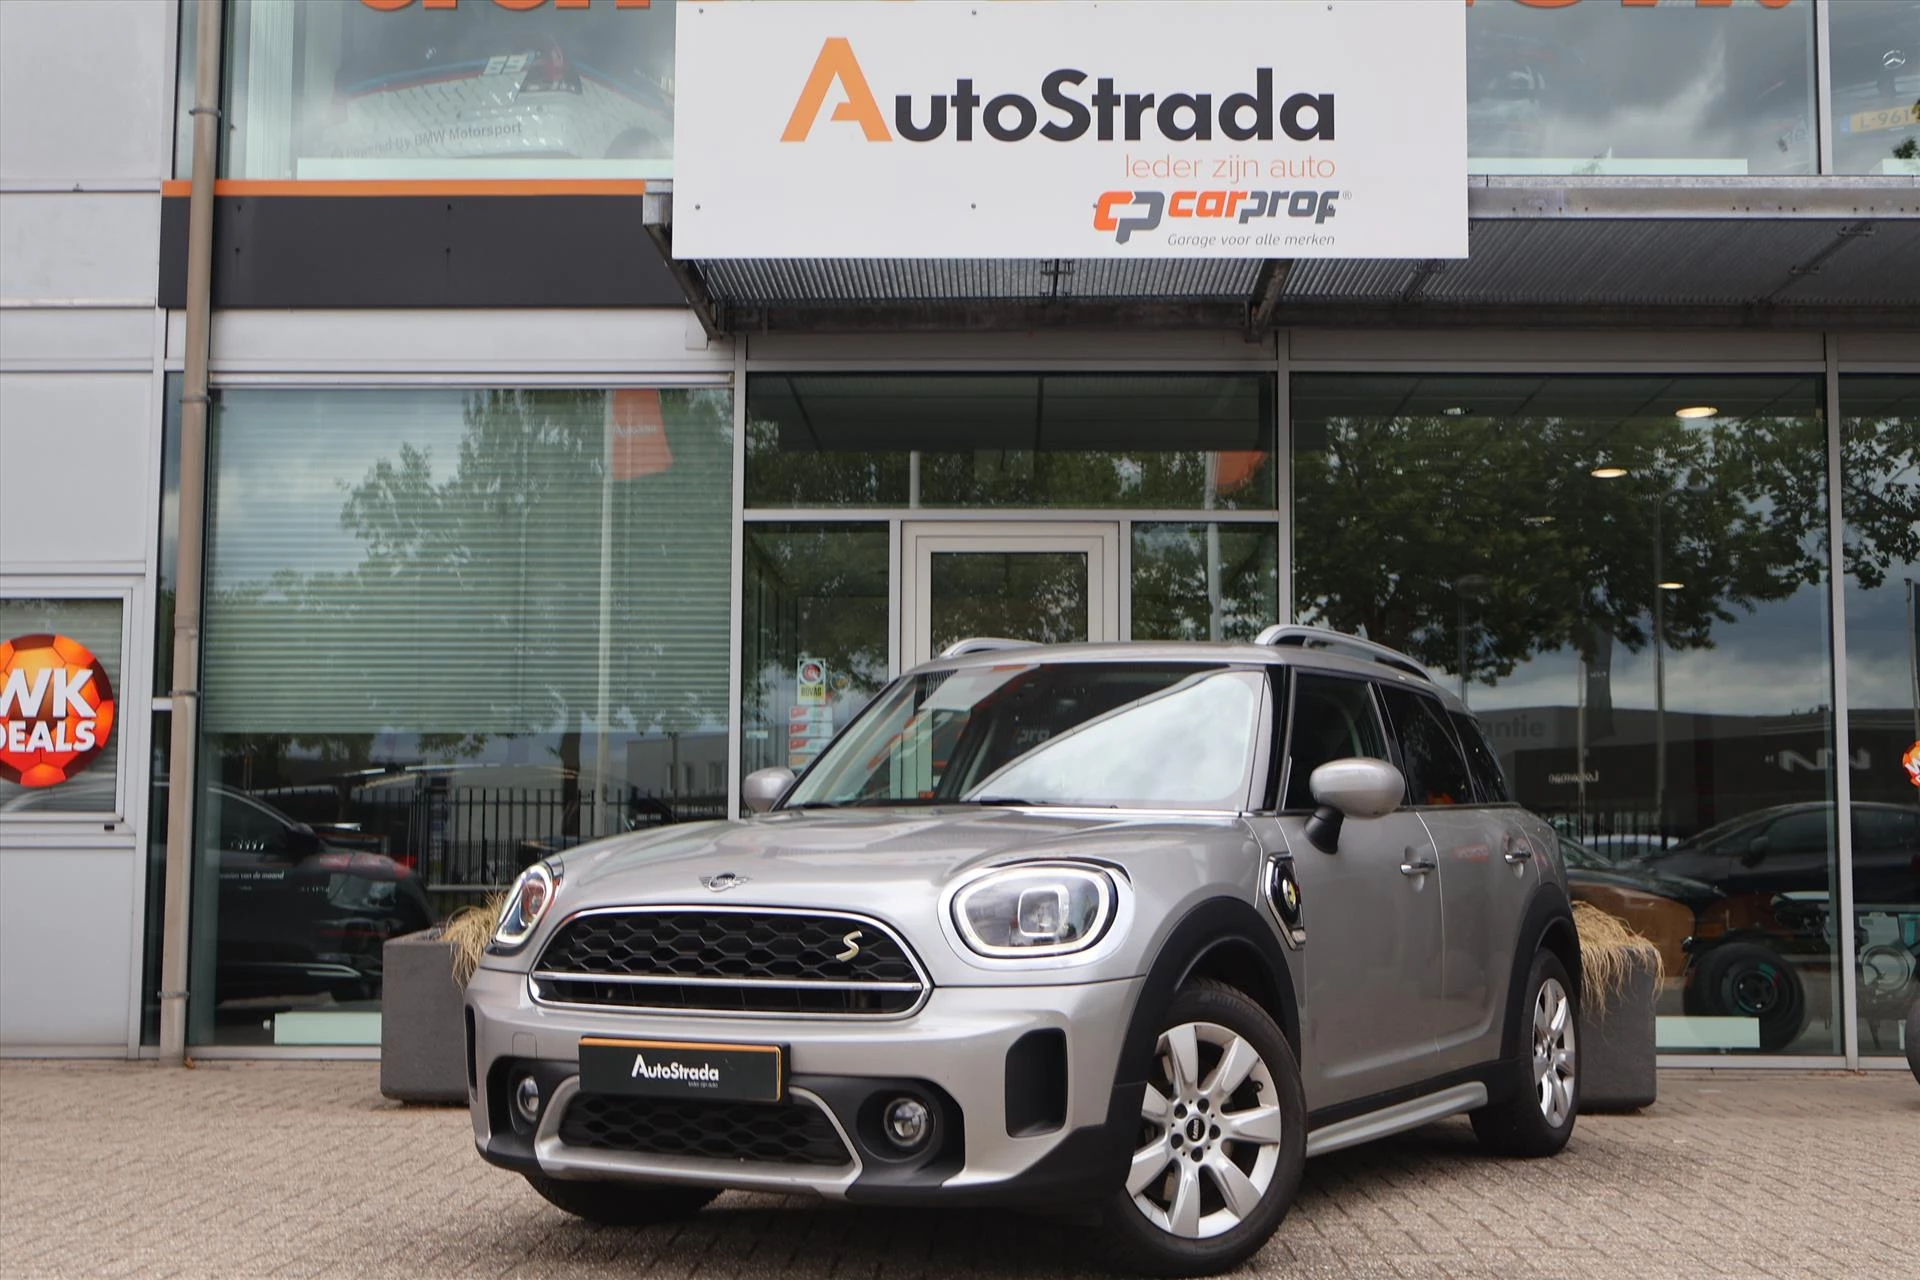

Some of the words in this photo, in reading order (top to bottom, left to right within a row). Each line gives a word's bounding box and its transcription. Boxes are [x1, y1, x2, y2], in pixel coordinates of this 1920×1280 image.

[780, 37, 1335, 143] AutoStrada
[1125, 154, 1203, 178] Ieder
[1212, 154, 1259, 184] zijn
[1270, 156, 1336, 178] auto
[1167, 233, 1217, 249] Garage
[1221, 235, 1251, 247] voor
[1255, 233, 1281, 247] alle
[1284, 233, 1336, 247] merken
[836, 930, 863, 972] S
[631, 1053, 720, 1081] AutoStrada
